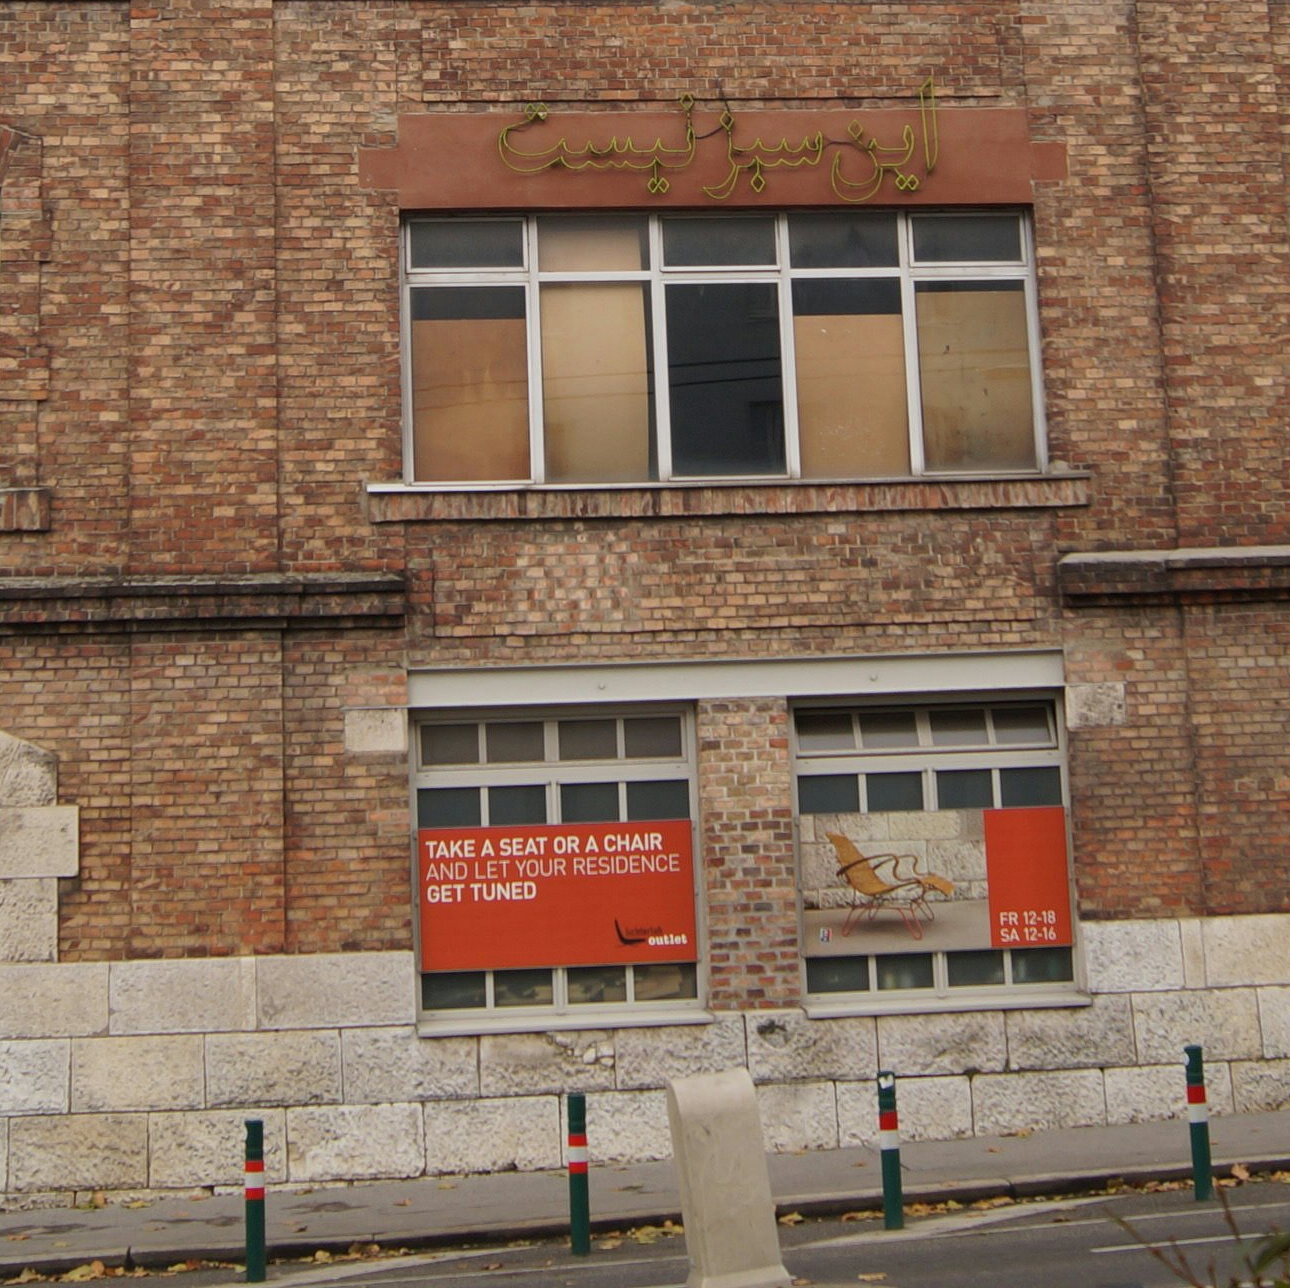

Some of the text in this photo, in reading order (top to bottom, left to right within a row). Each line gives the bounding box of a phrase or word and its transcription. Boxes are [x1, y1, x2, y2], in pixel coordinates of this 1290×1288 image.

[425, 832, 663, 859] TAKE A SEAT OR A CHAIR
[425, 853, 681, 881] AND LET YOUR RESIDENCE
[426, 881, 537, 904] GET TUNED
[999, 909, 1056, 926] FR 12-18
[647, 933, 688, 946] outlet
[1000, 926, 1057, 942] SA 12-16
